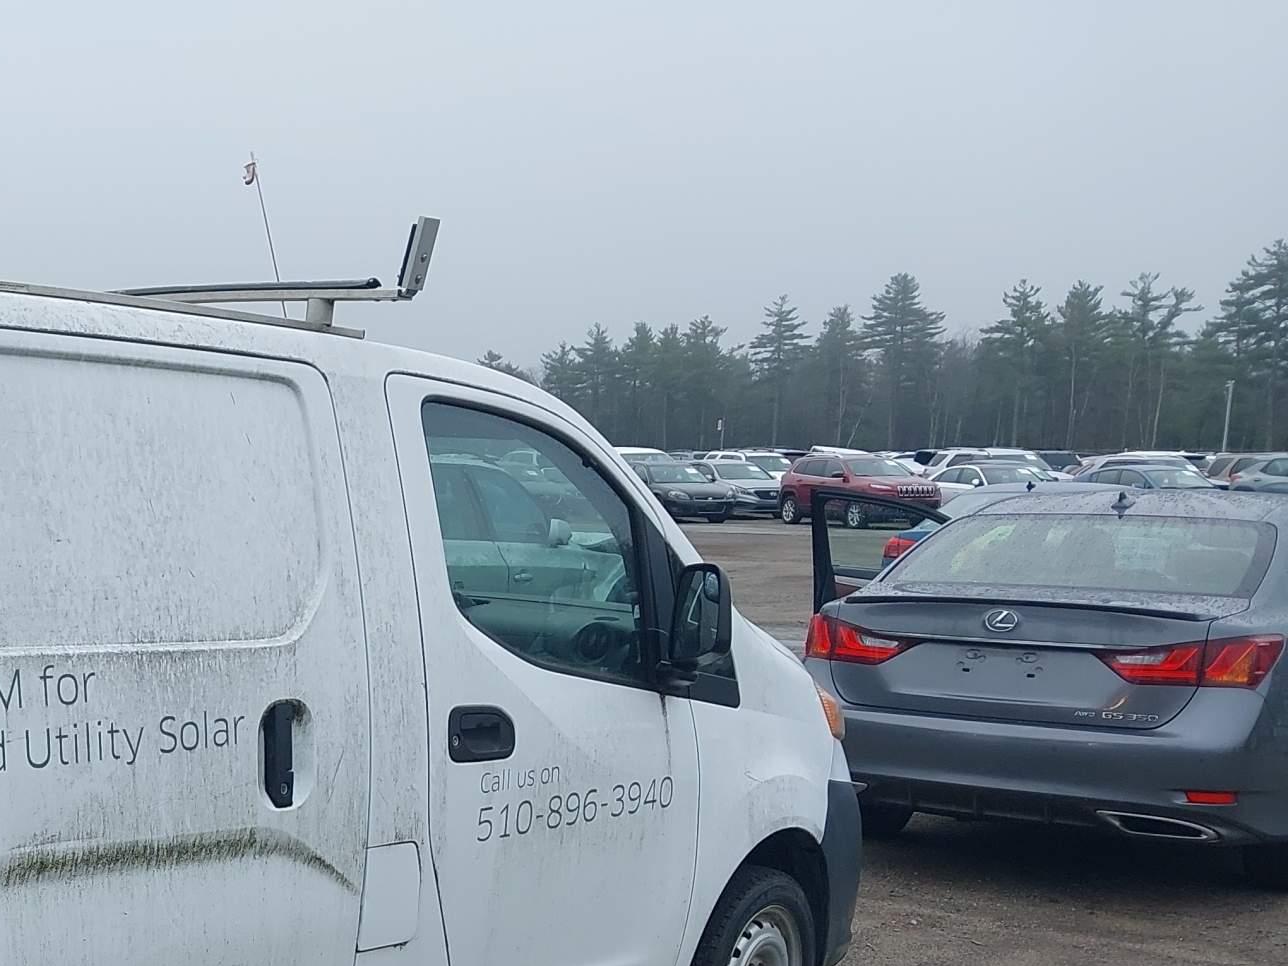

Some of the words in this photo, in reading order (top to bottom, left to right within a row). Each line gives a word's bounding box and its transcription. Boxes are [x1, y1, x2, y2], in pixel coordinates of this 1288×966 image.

[39, 665, 96, 708] for
[1102, 711, 1124, 720] GS
[24, 720, 145, 769] Utility
[158, 710, 246, 754] Solar
[480, 768, 511, 794] Call
[516, 769, 535, 789] us
[540, 766, 561, 785] on
[476, 776, 674, 842] 510-896-3940
